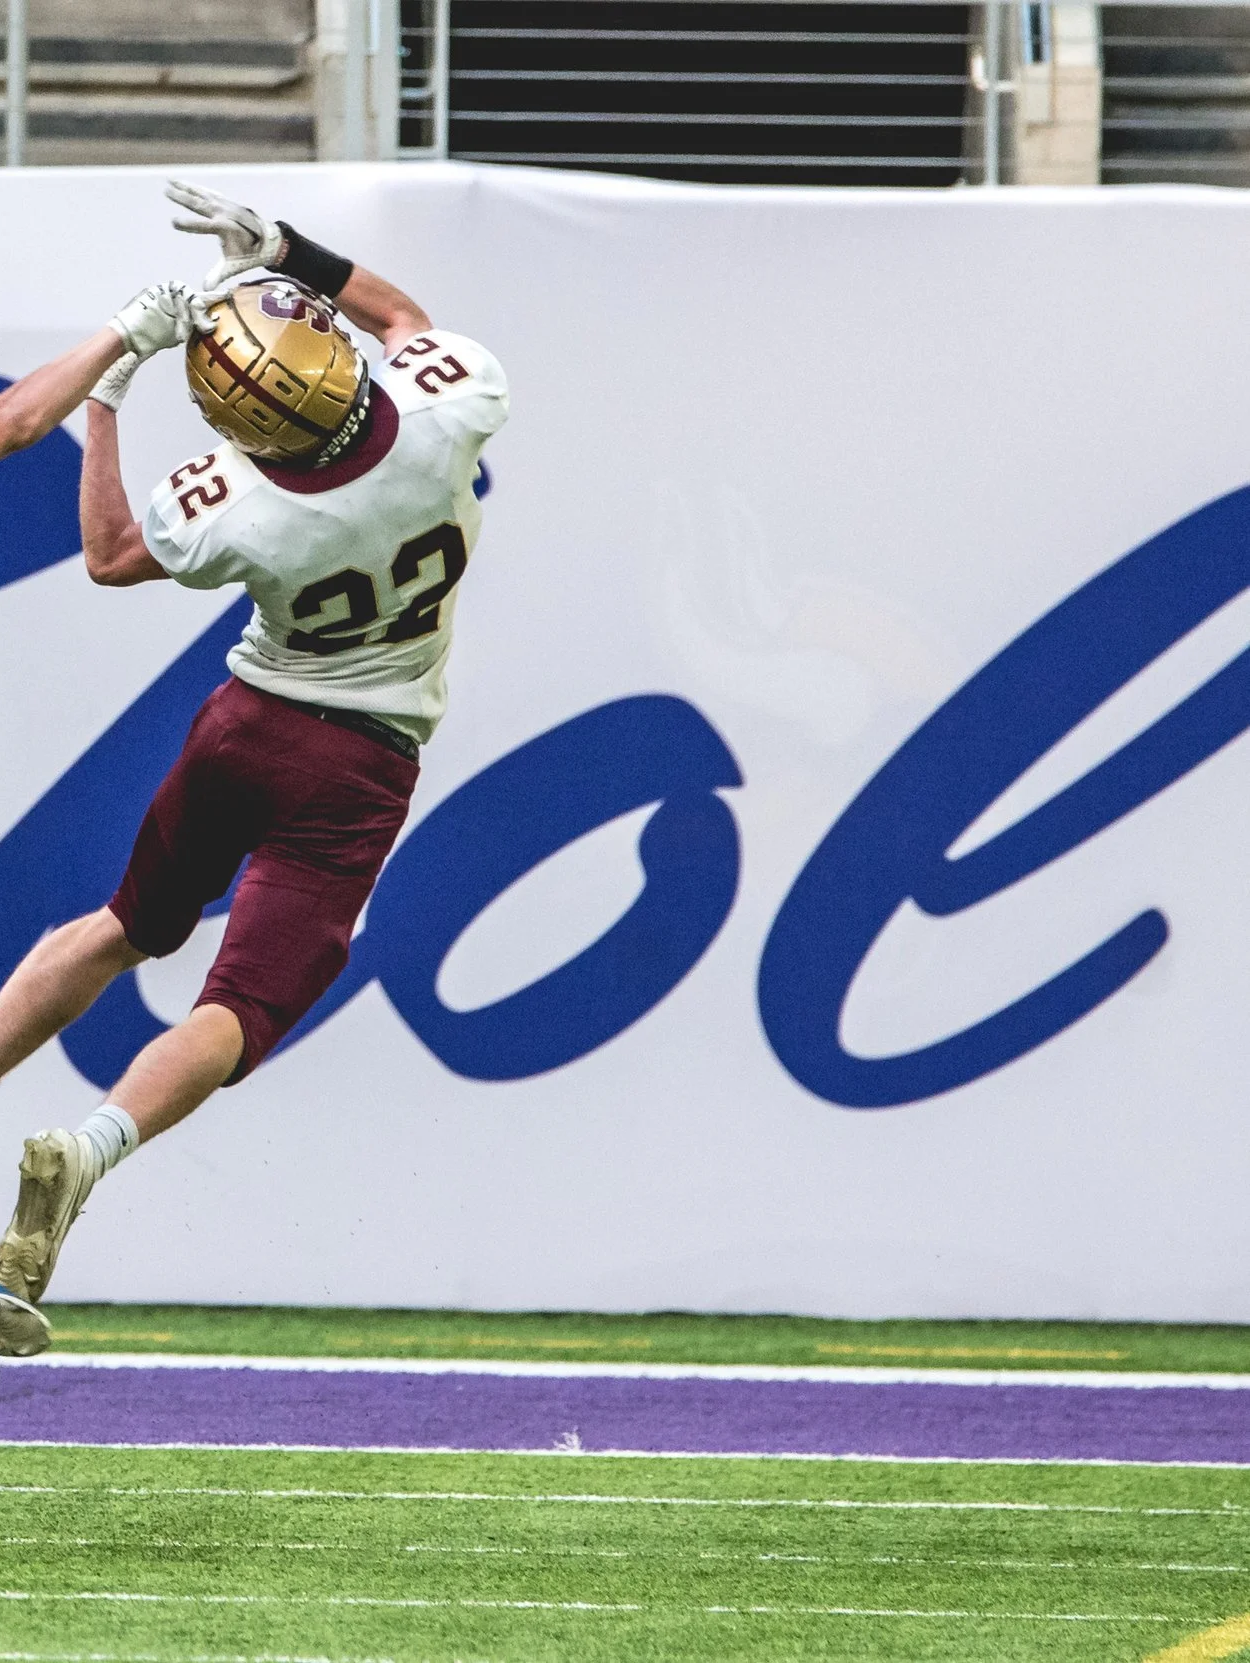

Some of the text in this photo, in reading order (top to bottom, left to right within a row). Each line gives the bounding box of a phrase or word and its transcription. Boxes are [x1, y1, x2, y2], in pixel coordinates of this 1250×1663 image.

[389, 337, 470, 395] 22
[169, 452, 230, 522] 22
[287, 521, 467, 655] 22
